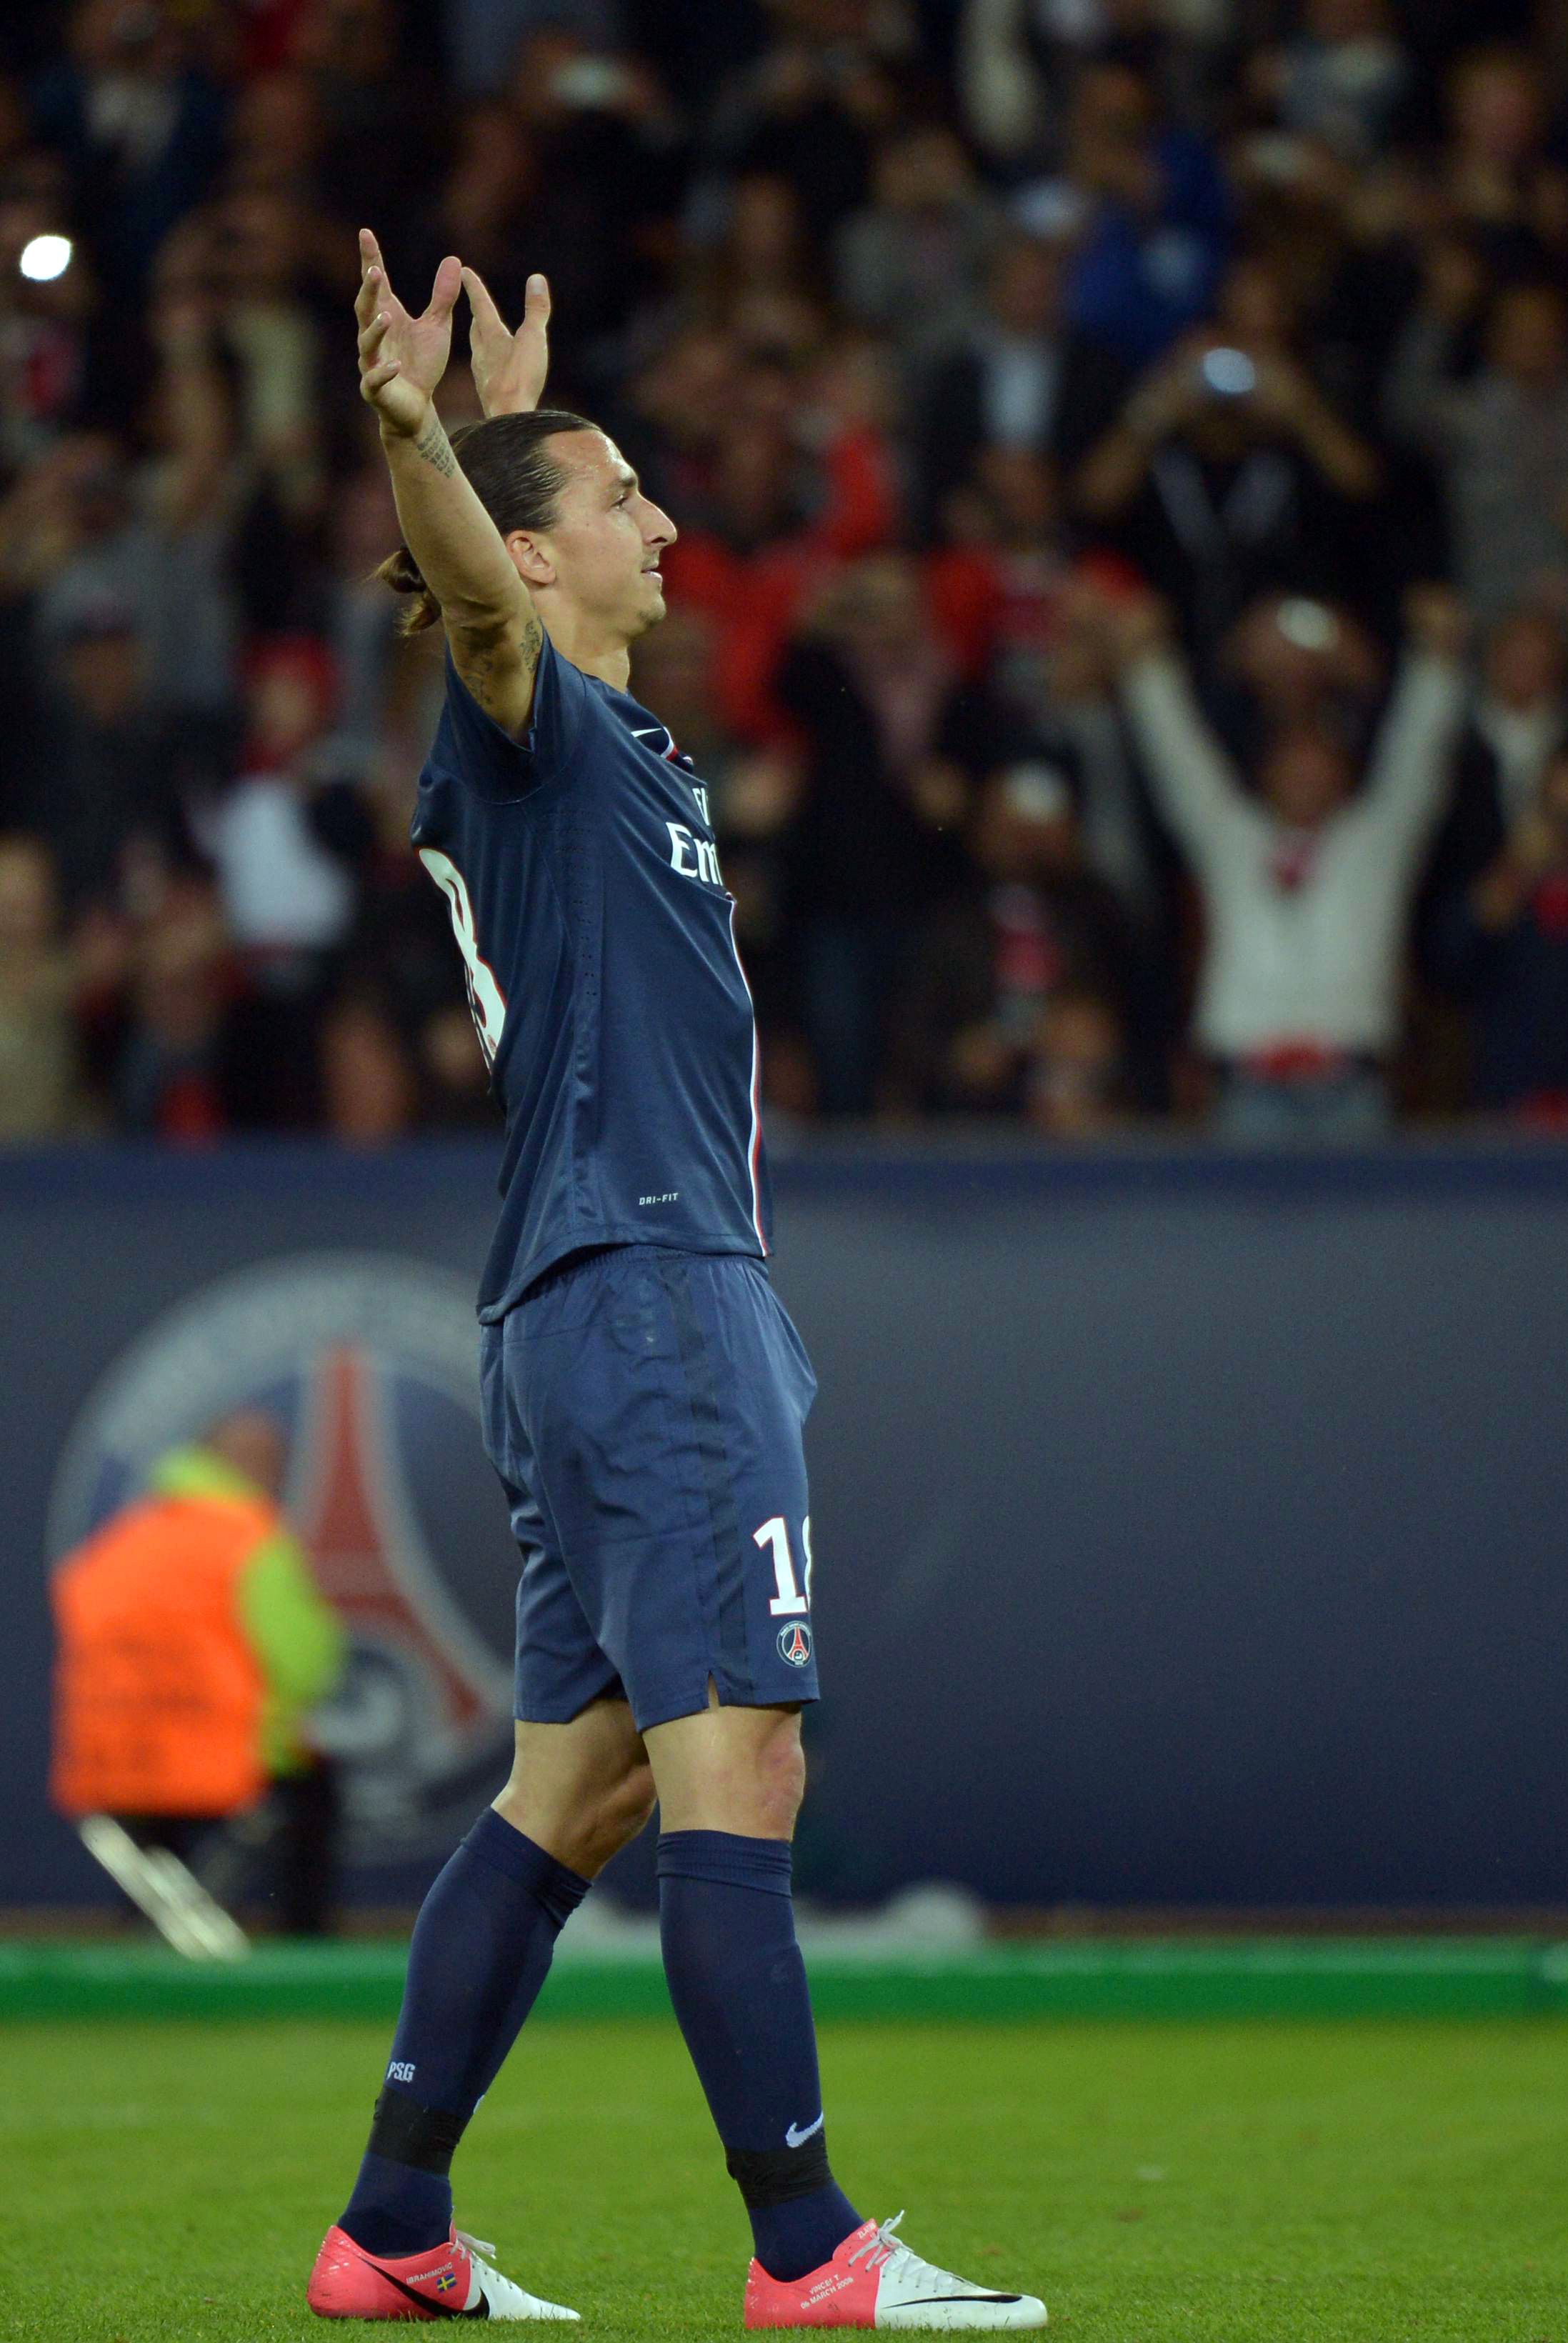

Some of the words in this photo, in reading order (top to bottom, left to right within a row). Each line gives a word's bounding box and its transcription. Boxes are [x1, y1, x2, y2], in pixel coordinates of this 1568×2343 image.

[639, 1192, 679, 1206] DRI-FIT
[386, 2062, 416, 2083] PSG
[809, 2285, 837, 2304] MARCH
